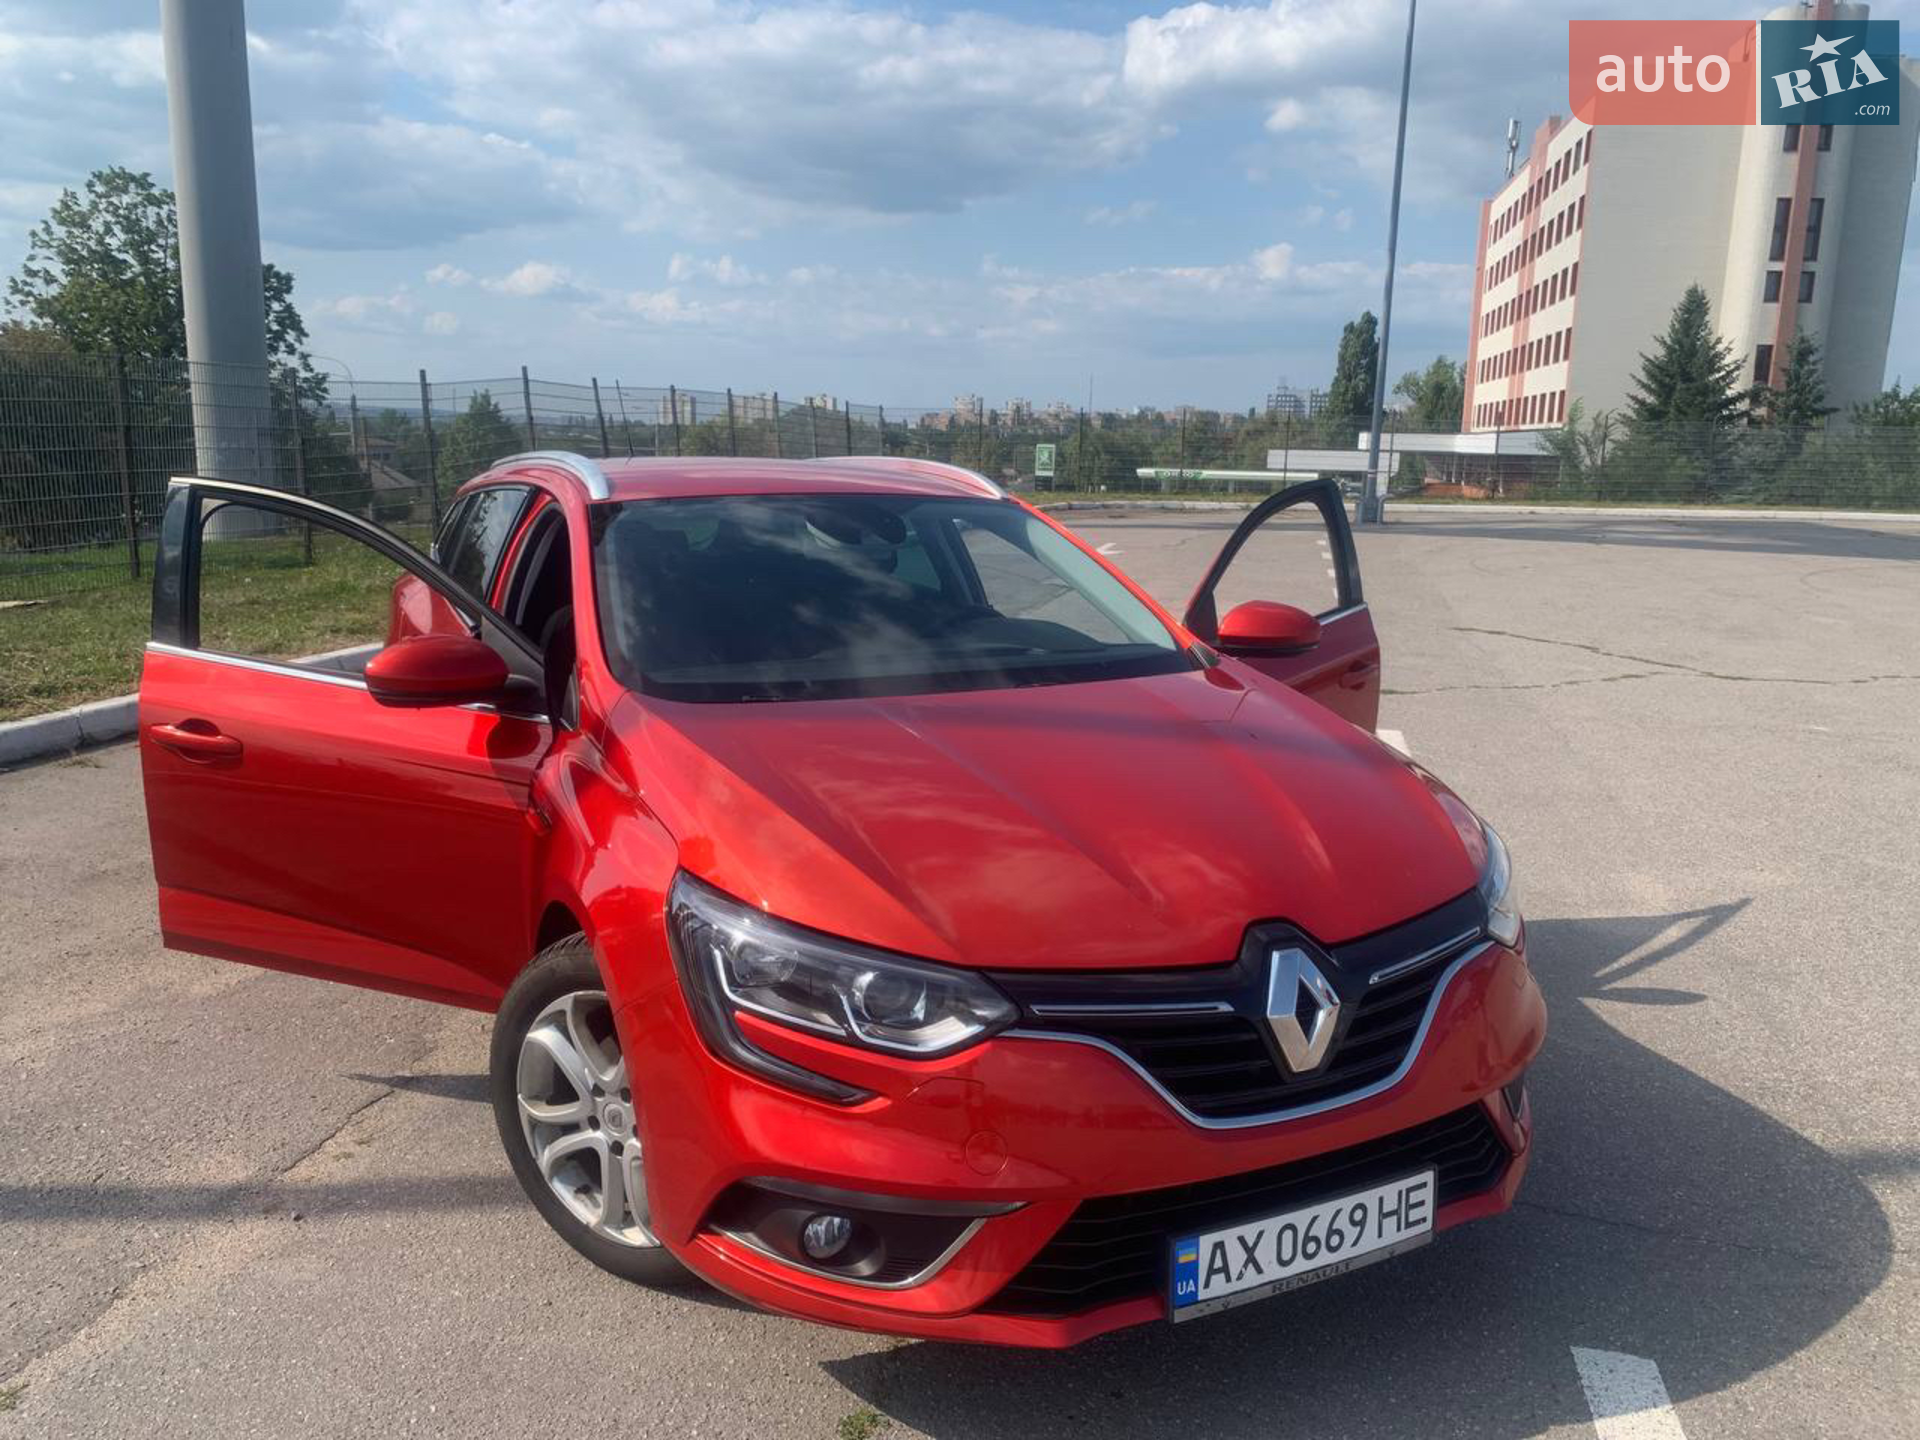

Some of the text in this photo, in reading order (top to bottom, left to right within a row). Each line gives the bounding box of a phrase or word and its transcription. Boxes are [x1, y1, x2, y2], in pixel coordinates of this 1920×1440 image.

[1203, 1181, 1428, 1290] AX 0669 HE
[1177, 1279, 1197, 1295] UA
[1271, 1262, 1350, 1294] RENAULT
